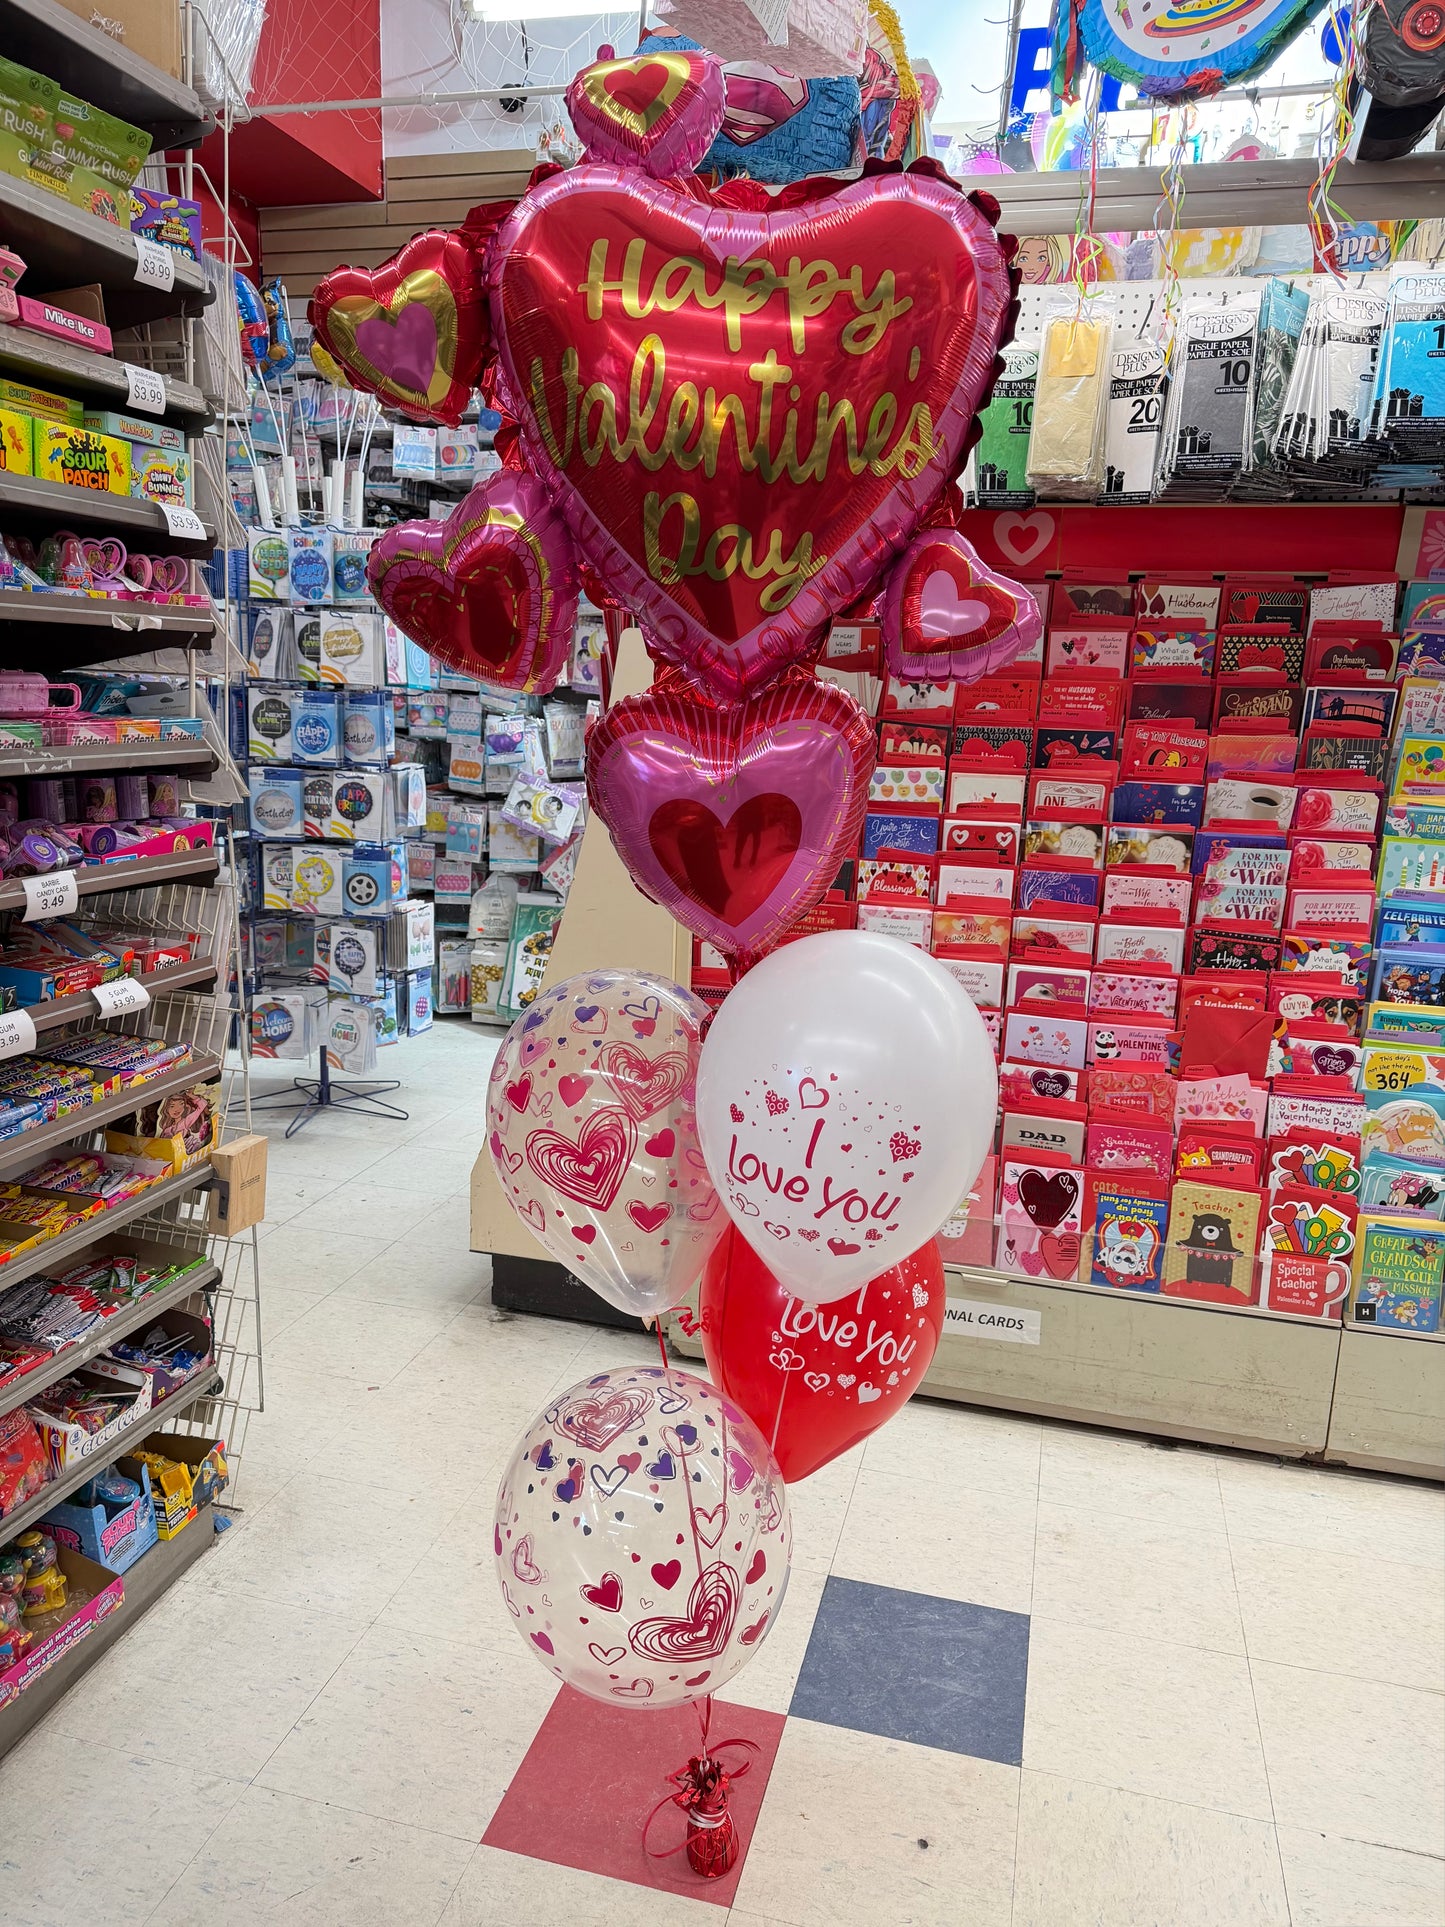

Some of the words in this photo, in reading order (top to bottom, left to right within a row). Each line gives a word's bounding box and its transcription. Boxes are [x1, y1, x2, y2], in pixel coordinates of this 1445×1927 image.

[5, 109, 45, 142] RUSH
[52, 140, 100, 171] GUMMY
[102, 161, 135, 186] RUSH
[1335, 235, 1391, 265] appy
[142, 258, 171, 280] $3.99
[578, 238, 913, 356] Happy
[1336, 297, 1387, 312] DESIGNS
[1195, 313, 1250, 328] DESIGNS
[1344, 308, 1375, 321] PLUS
[44, 307, 75, 331] Mike
[78, 320, 95, 339] Ike
[1203, 324, 1235, 338] PLUS
[1189, 341, 1218, 352] TISSUE
[1220, 340, 1250, 349] PAPER
[1117, 351, 1160, 366] DESIGNS
[1187, 350, 1215, 360] PAPIER
[1229, 348, 1251, 357] SOIE
[1122, 361, 1148, 376] PLUS
[1219, 359, 1251, 386] 10
[1112, 380, 1136, 392] TISSUE
[1136, 378, 1159, 388] PAPER
[8, 385, 31, 401] SOUR
[134, 385, 163, 404] $3.99
[1129, 398, 1161, 425] 20
[119, 419, 154, 440] WARHEADS
[63, 448, 107, 472] SOUR
[63, 468, 109, 492] PATCH
[147, 481, 184, 498] BUNNIES
[170, 514, 200, 531] $3.99
[293, 537, 324, 549] balloon
[644, 491, 828, 612] Day
[1168, 593, 1217, 609] Husband
[1161, 647, 1179, 655] What
[72, 732, 110, 746] Trident
[121, 732, 156, 745] Trident
[165, 731, 197, 743] Trident
[296, 724, 329, 740] HAPPY
[342, 787, 367, 802] HAPPY
[1345, 794, 1366, 807] To
[255, 805, 294, 819] Birthday
[337, 799, 370, 812] BIRTHDAY
[1329, 807, 1372, 823] Woman
[872, 820, 897, 842] You're
[901, 824, 915, 836] my
[1067, 838, 1089, 853] Wife
[1338, 846, 1359, 859] To
[1153, 847, 1177, 863] Wife
[1242, 853, 1260, 861] FOR
[1263, 854, 1280, 862] MY
[1234, 862, 1283, 871] AMAZING
[41, 877, 61, 888] BARBIE
[1230, 868, 1283, 886] Wife
[36, 887, 54, 898] CANDY
[54, 884, 70, 895] CASE
[873, 879, 916, 895] Blessings
[1236, 889, 1255, 897] FOR
[1257, 889, 1275, 898] MY
[41, 894, 65, 911] 3.49
[1228, 897, 1278, 906] AMAZING
[1225, 904, 1278, 920] Wife
[154, 956, 183, 971] Trident
[1211, 951, 1246, 967] Happy
[1313, 955, 1333, 963] What
[113, 987, 129, 997] GUM
[1057, 988, 1085, 998] SPECIAL!
[1387, 986, 1410, 997] Hope
[112, 995, 136, 1010] $3.99
[1204, 1000, 1256, 1011] Valentine
[1282, 1000, 1296, 1010] LUV
[1297, 1000, 1310, 1010] YA!
[1380, 1015, 1403, 1025] Bringing
[261, 1023, 293, 1038] HOME
[331, 1027, 358, 1043] HOME!
[1117, 1039, 1169, 1052] VALENTINE'S
[1140, 1051, 1162, 1062] DAY
[1378, 1063, 1390, 1071] like
[1404, 1065, 1422, 1073] other
[1376, 1072, 1413, 1090] 364.
[1113, 1097, 1145, 1106] Mother
[1198, 1086, 1248, 1104] Mother
[1302, 1103, 1332, 1116] Happy
[1279, 1111, 1330, 1125] Valentine's
[1019, 1129, 1067, 1143] DAD
[805, 1118, 826, 1169] I
[1103, 1137, 1153, 1150] Grandma
[1407, 1145, 1433, 1153] Great-
[1211, 1150, 1253, 1164] GRANDPARENTS
[1100, 1195, 1120, 1204] fun!
[1121, 1197, 1134, 1205] for
[1136, 1198, 1154, 1207] ready
[1116, 1204, 1129, 1213] up
[1130, 1207, 1154, 1217] fired
[1193, 1200, 1235, 1214] Teacher
[1104, 1212, 1138, 1224] you're
[1139, 1217, 1159, 1227] Hope
[1373, 1235, 1409, 1251] GREAT-
[1277, 1263, 1315, 1277] Special
[1372, 1266, 1400, 1278] HERE'S
[1402, 1269, 1435, 1285] YOUR
[1276, 1276, 1318, 1290] Teacher
[1276, 1295, 1305, 1304] Valentine's
[978, 1314, 1025, 1331] CARDS
[117, 1401, 141, 1431] POP
[169, 1507, 190, 1528] Tonka
[101, 1509, 136, 1541] SOUR
[26, 1638, 54, 1666] Gumball
[55, 1617, 82, 1643] Machine
[18, 1662, 41, 1686] Machine
[72, 1618, 93, 1638] Gomme
